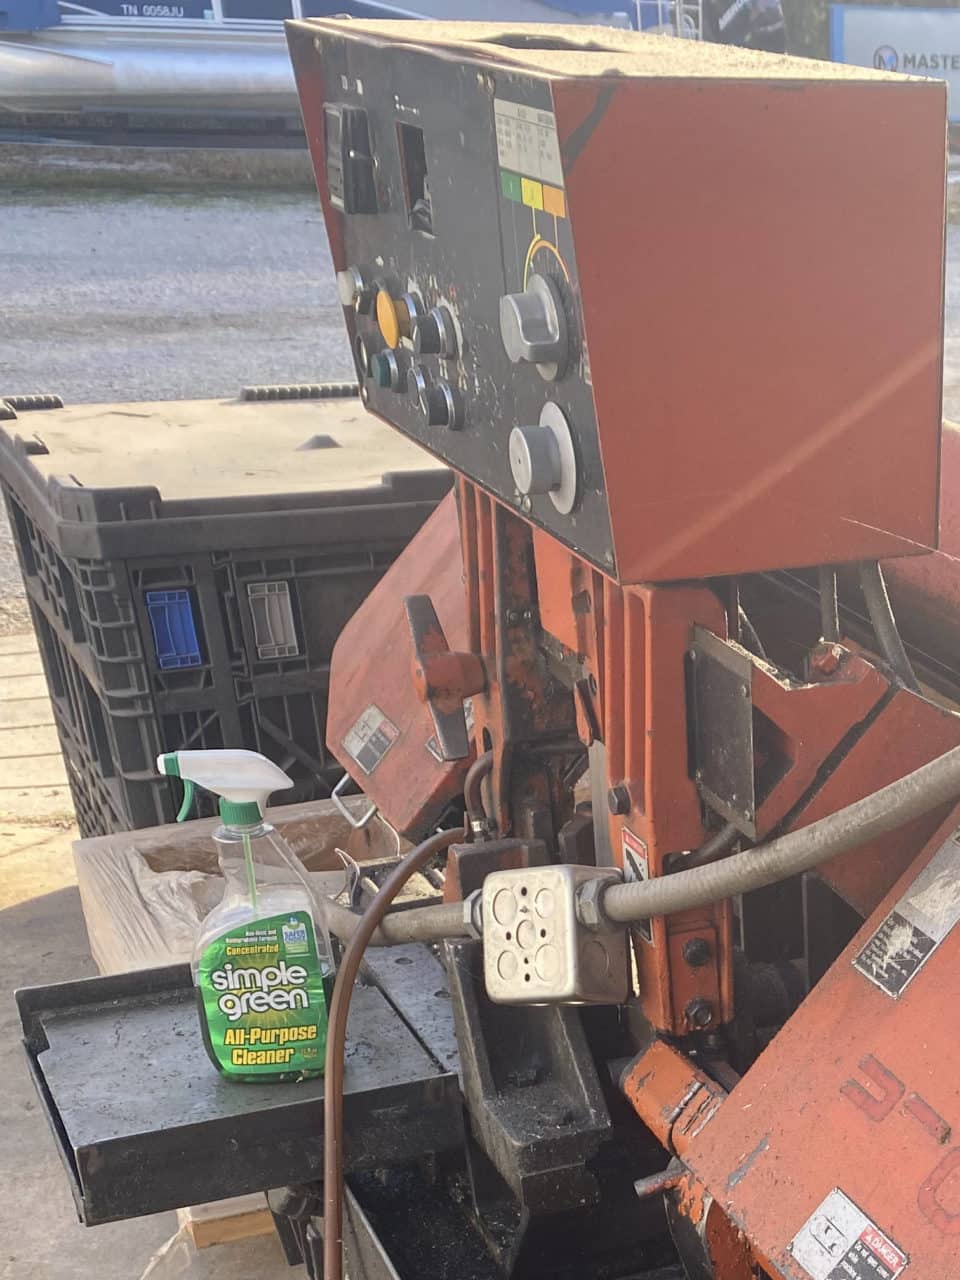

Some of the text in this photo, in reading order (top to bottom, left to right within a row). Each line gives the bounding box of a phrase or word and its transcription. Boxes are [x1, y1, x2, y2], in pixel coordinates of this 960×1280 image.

[120, 4, 138, 16] TN
[212, 961, 308, 992] simple
[219, 988, 309, 1021] green
[225, 1026, 317, 1045] All-Purpose
[232, 1048, 294, 1065] Cleaner
